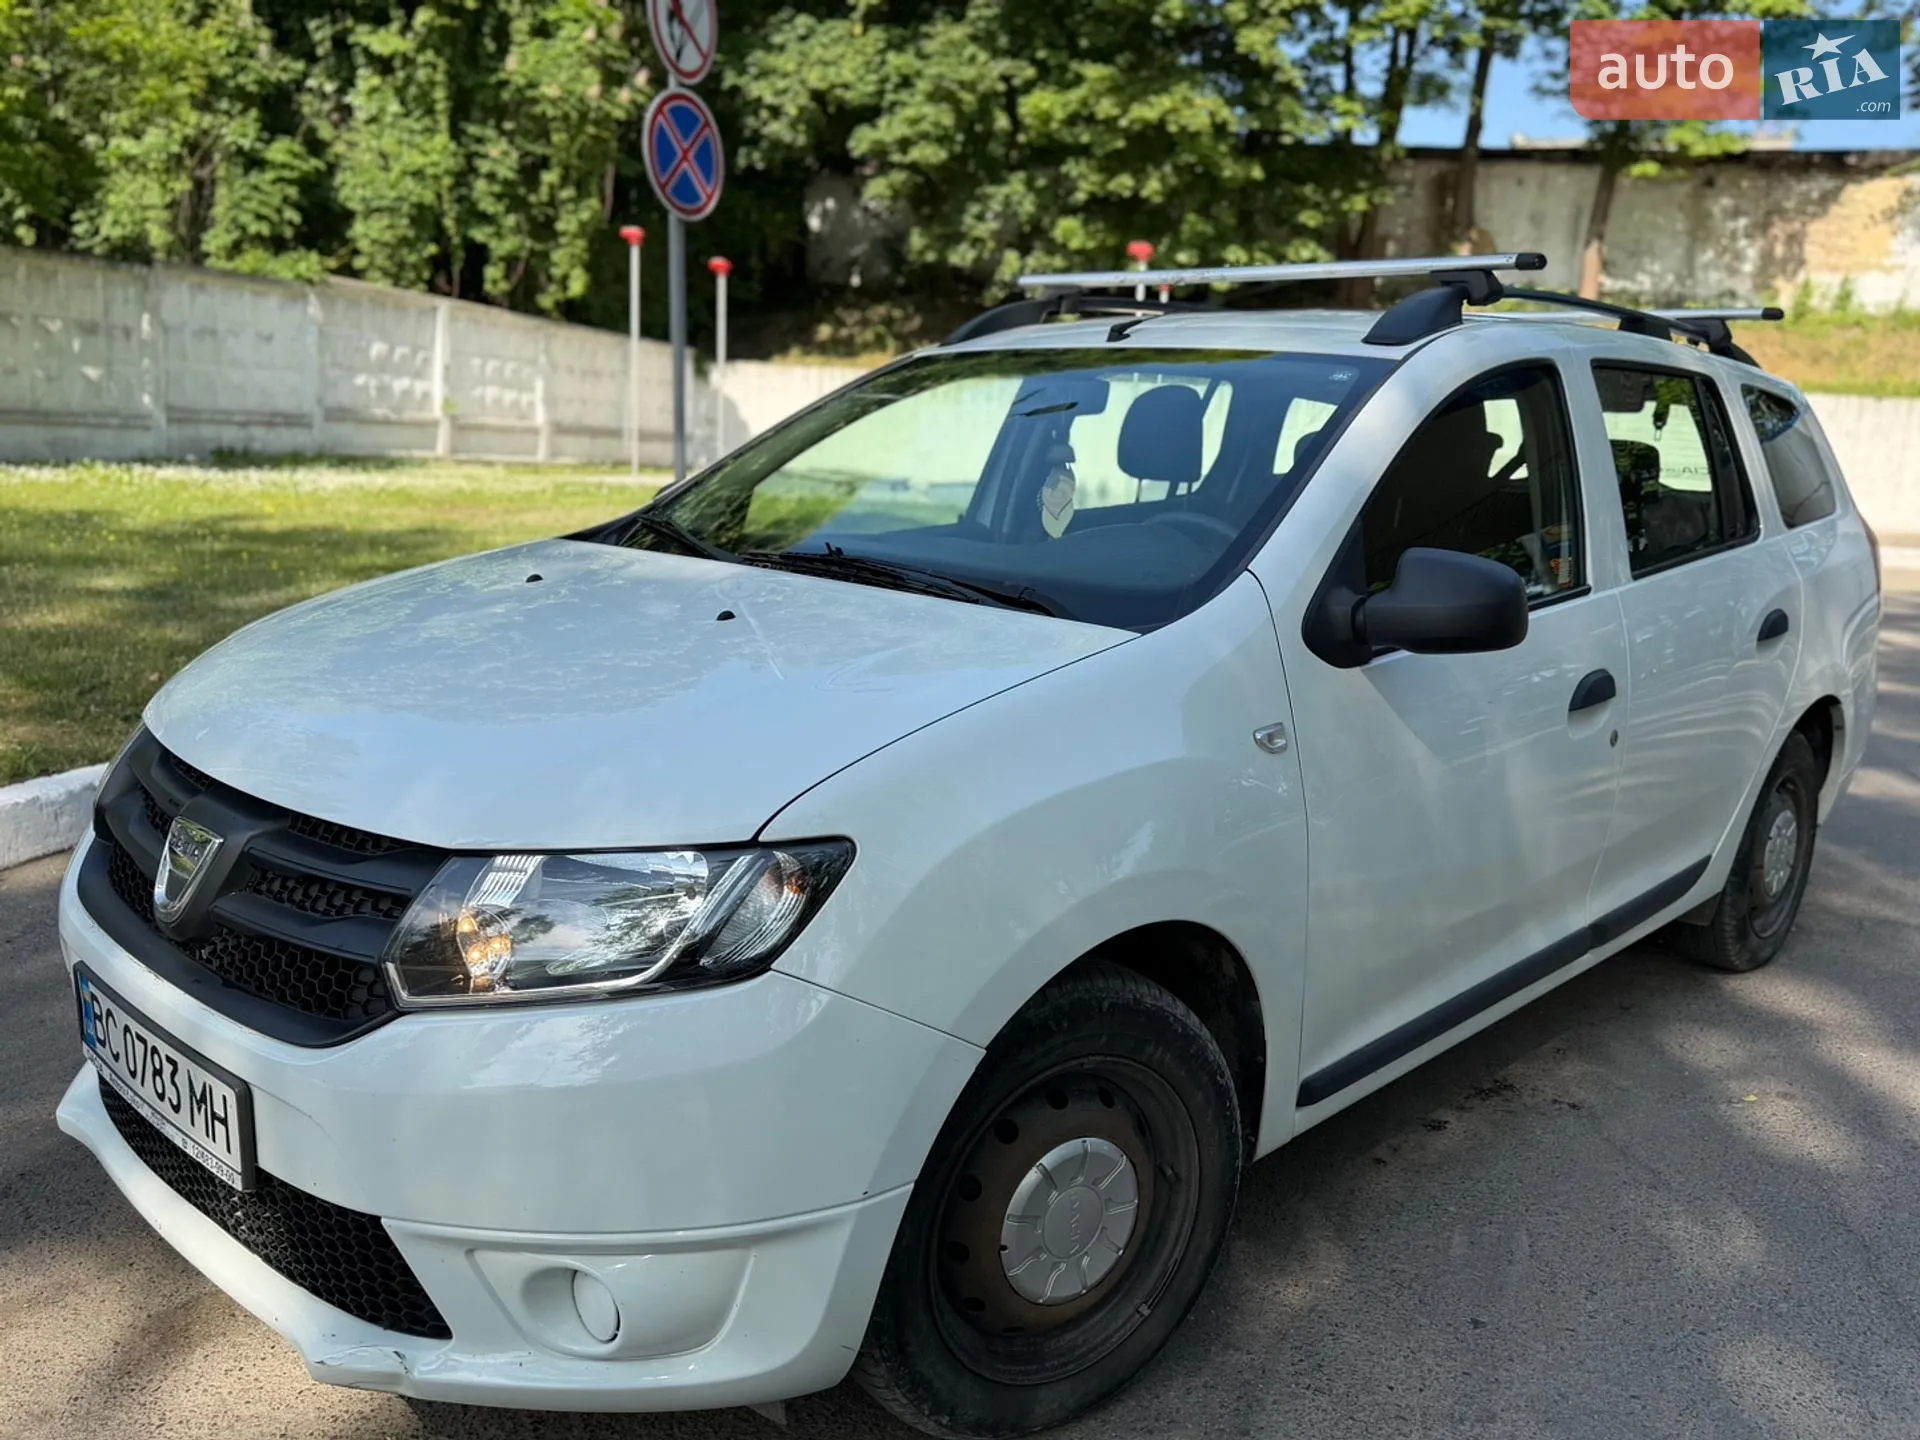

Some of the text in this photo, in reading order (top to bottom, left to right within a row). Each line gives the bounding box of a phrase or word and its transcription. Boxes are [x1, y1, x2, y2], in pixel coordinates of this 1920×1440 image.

[91, 990, 120, 1063] BC
[123, 1023, 182, 1115] 0783
[187, 1069, 232, 1155] MH
